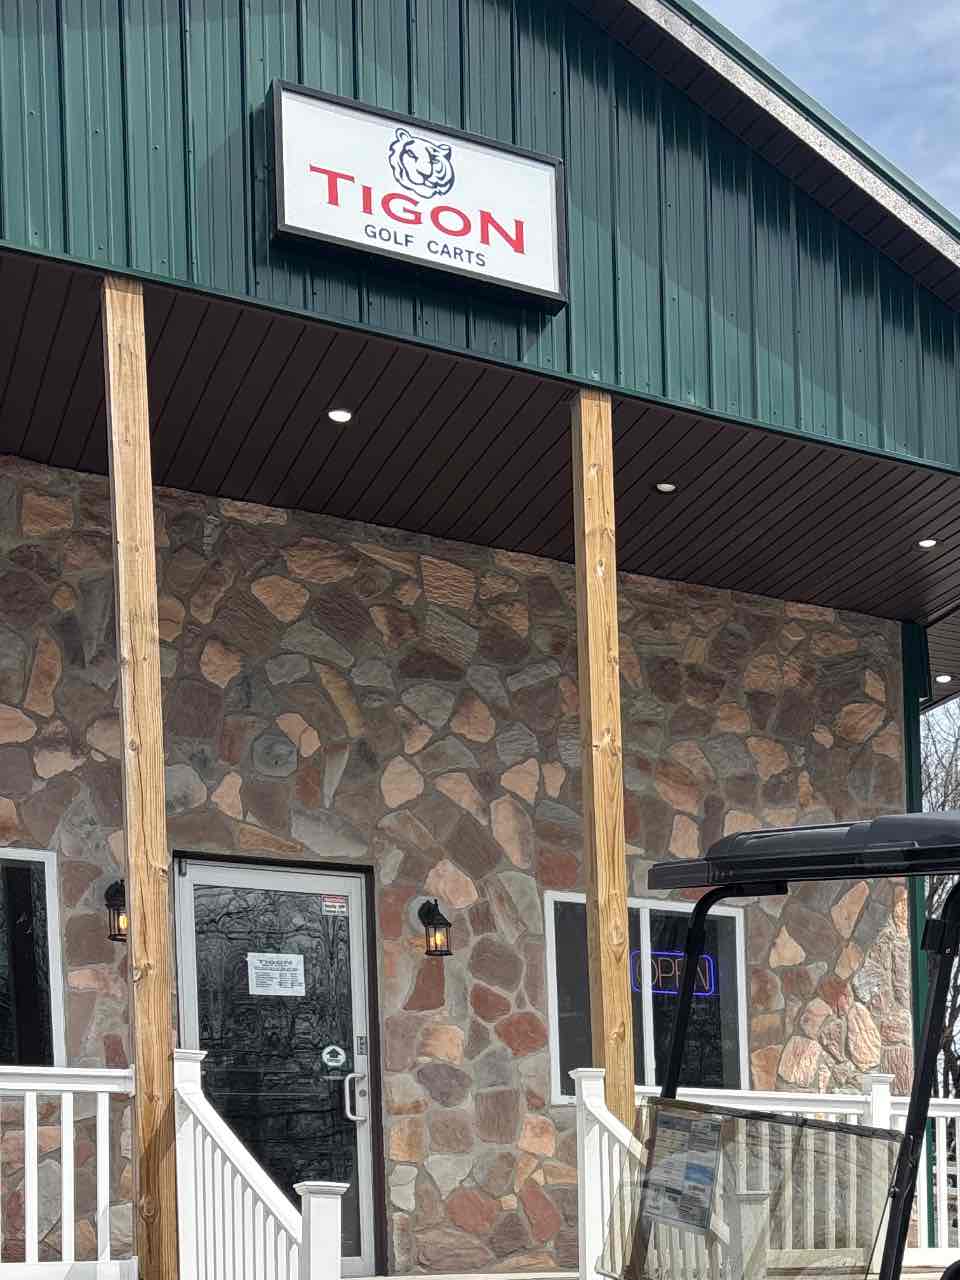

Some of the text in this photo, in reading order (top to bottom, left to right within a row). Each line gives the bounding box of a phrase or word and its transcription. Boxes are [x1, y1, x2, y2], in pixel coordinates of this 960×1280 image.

[309, 164, 525, 255] TIGON
[364, 224, 486, 267] GOLF CARTS
